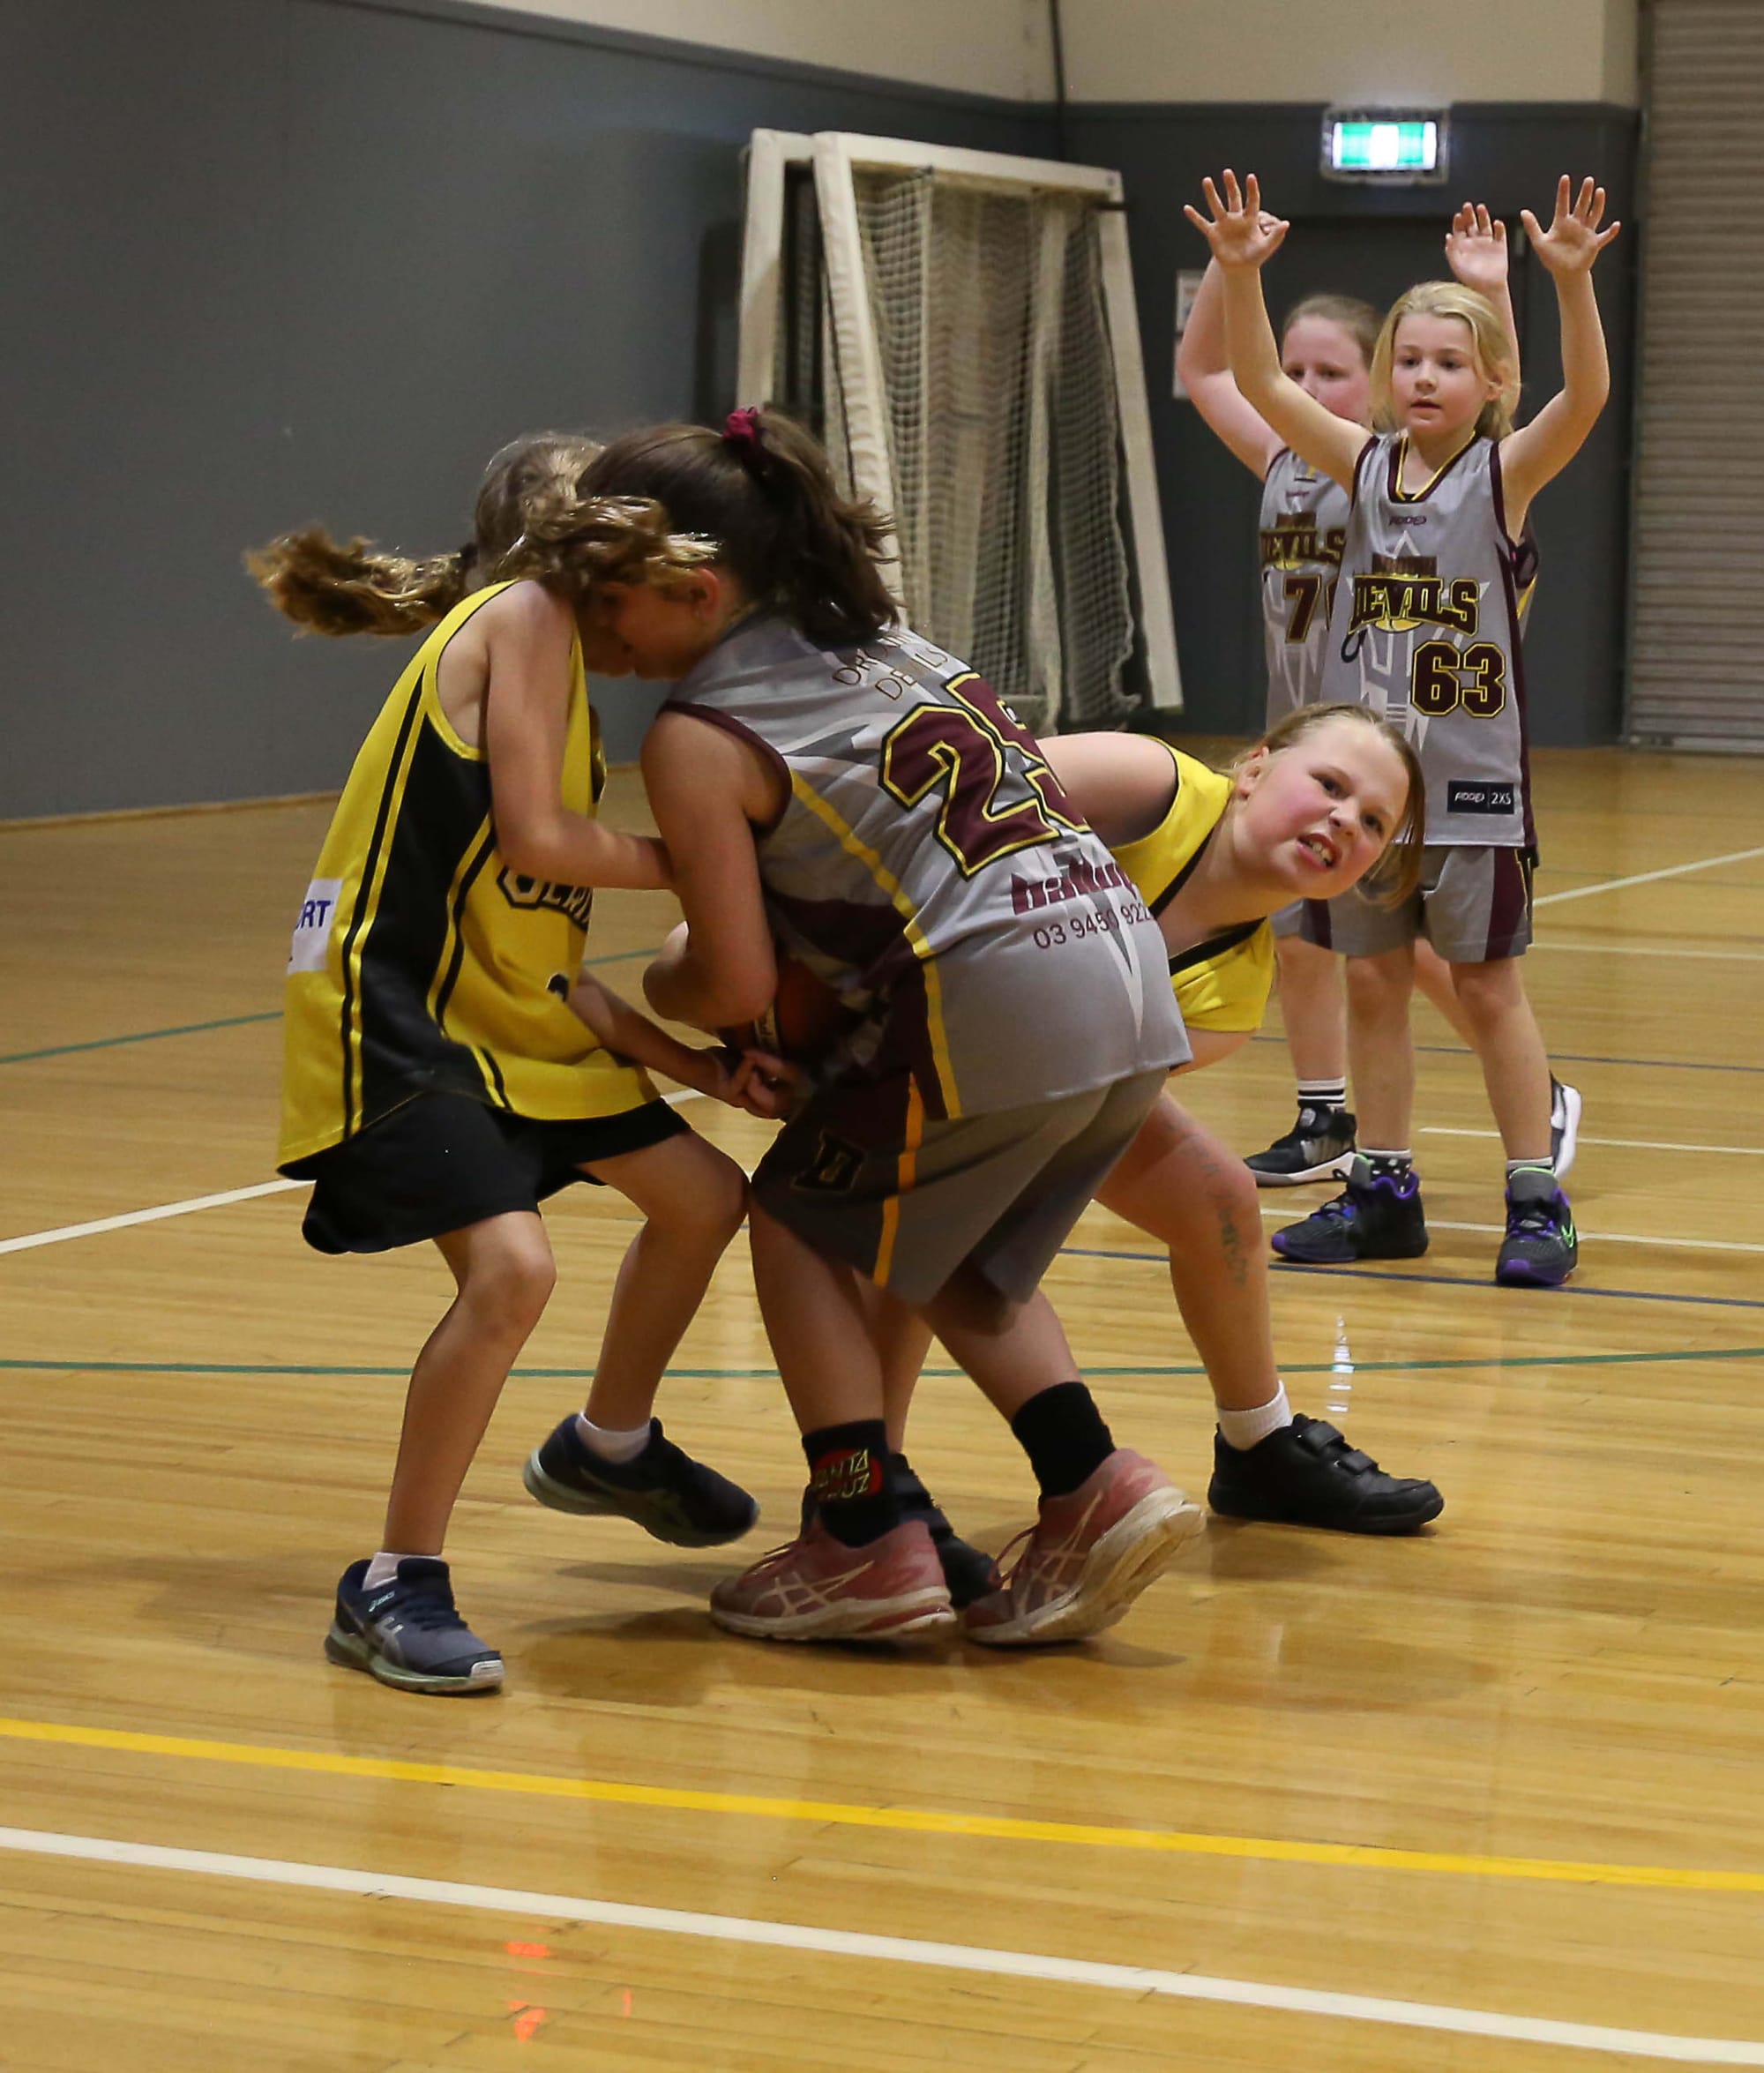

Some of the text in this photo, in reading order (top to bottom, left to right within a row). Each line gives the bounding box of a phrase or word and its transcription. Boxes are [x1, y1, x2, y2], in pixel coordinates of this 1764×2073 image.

[1348, 574, 1480, 638] DEVILS
[875, 647, 949, 700] DEILS
[1411, 640, 1506, 719] 63
[296, 900, 333, 929] RT
[1033, 924, 1067, 950] 03
[1070, 909, 1119, 939] 9450
